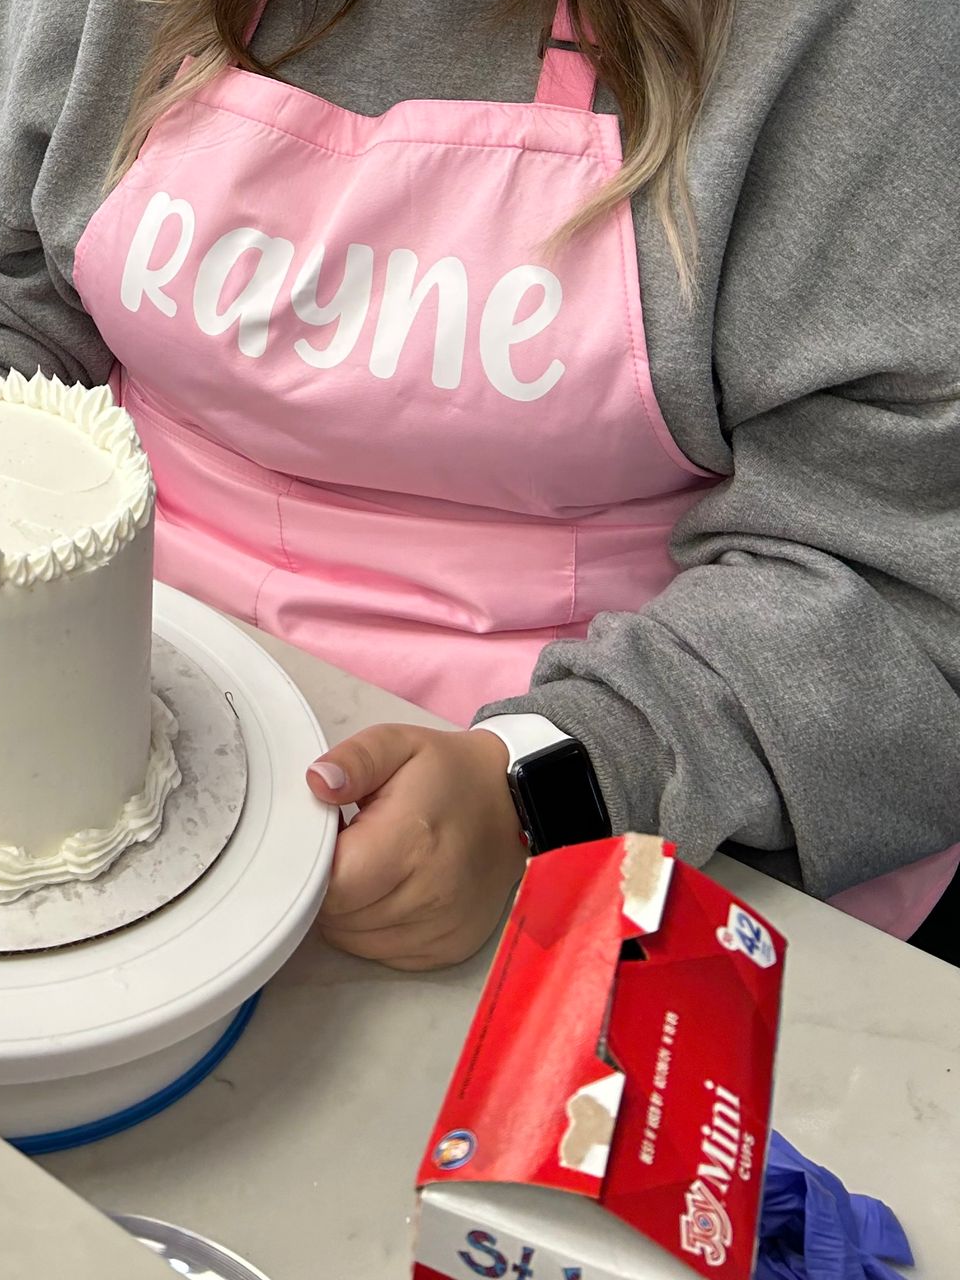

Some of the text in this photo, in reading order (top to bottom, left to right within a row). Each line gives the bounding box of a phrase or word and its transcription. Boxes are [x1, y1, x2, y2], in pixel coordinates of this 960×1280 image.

[120, 191, 566, 402] Rayne
[735, 912, 761, 955] 42
[696, 1079, 741, 1194] Mini
[738, 1132, 755, 1181] CUPS
